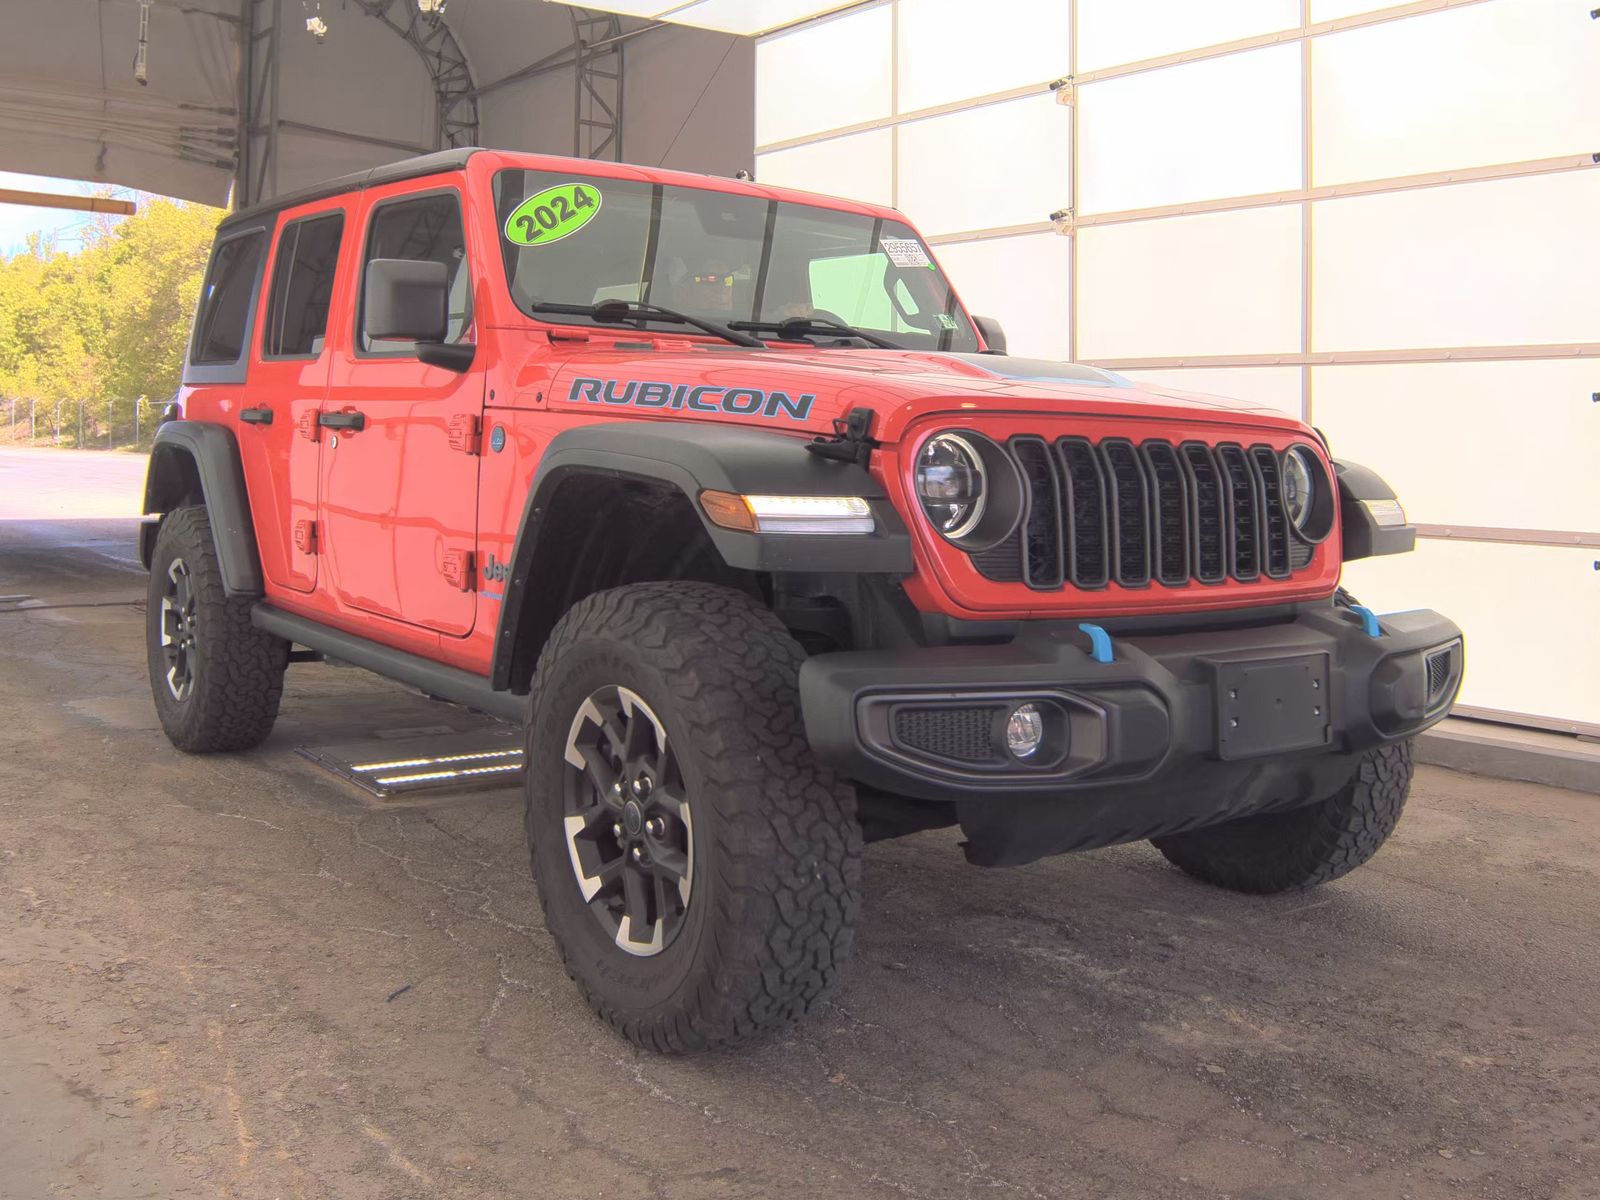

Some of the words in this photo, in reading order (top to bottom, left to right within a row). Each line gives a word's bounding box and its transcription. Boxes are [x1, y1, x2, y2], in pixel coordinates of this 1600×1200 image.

[516, 186, 595, 242] 2024
[568, 378, 816, 421] RUBICON
[482, 553, 512, 583] Jee
